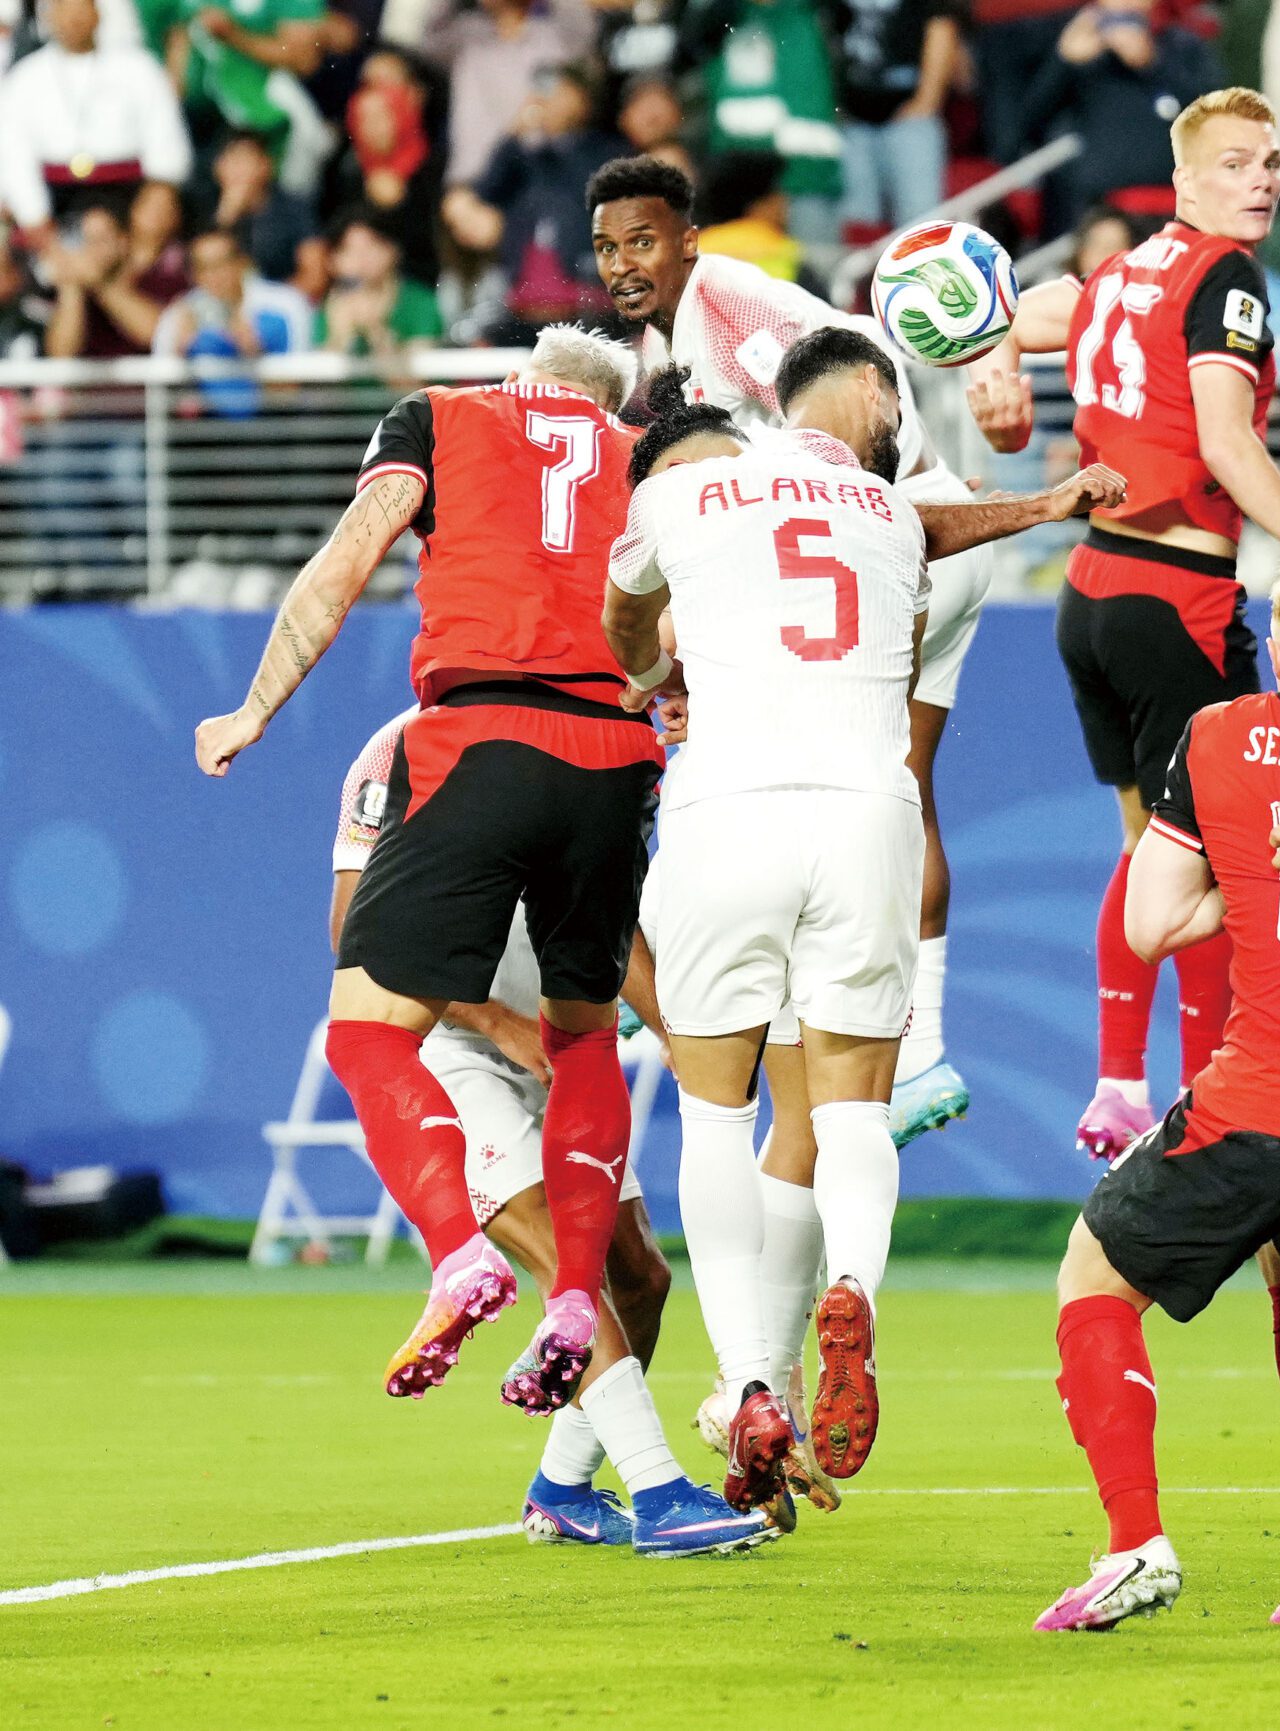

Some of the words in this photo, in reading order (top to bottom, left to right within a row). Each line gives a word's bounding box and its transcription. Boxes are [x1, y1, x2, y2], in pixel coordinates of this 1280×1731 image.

[1070, 271, 1164, 421] 15
[525, 408, 606, 554] 7
[698, 478, 764, 516] AL
[772, 517, 860, 662] 5
[482, 1151, 508, 1171] KELME
